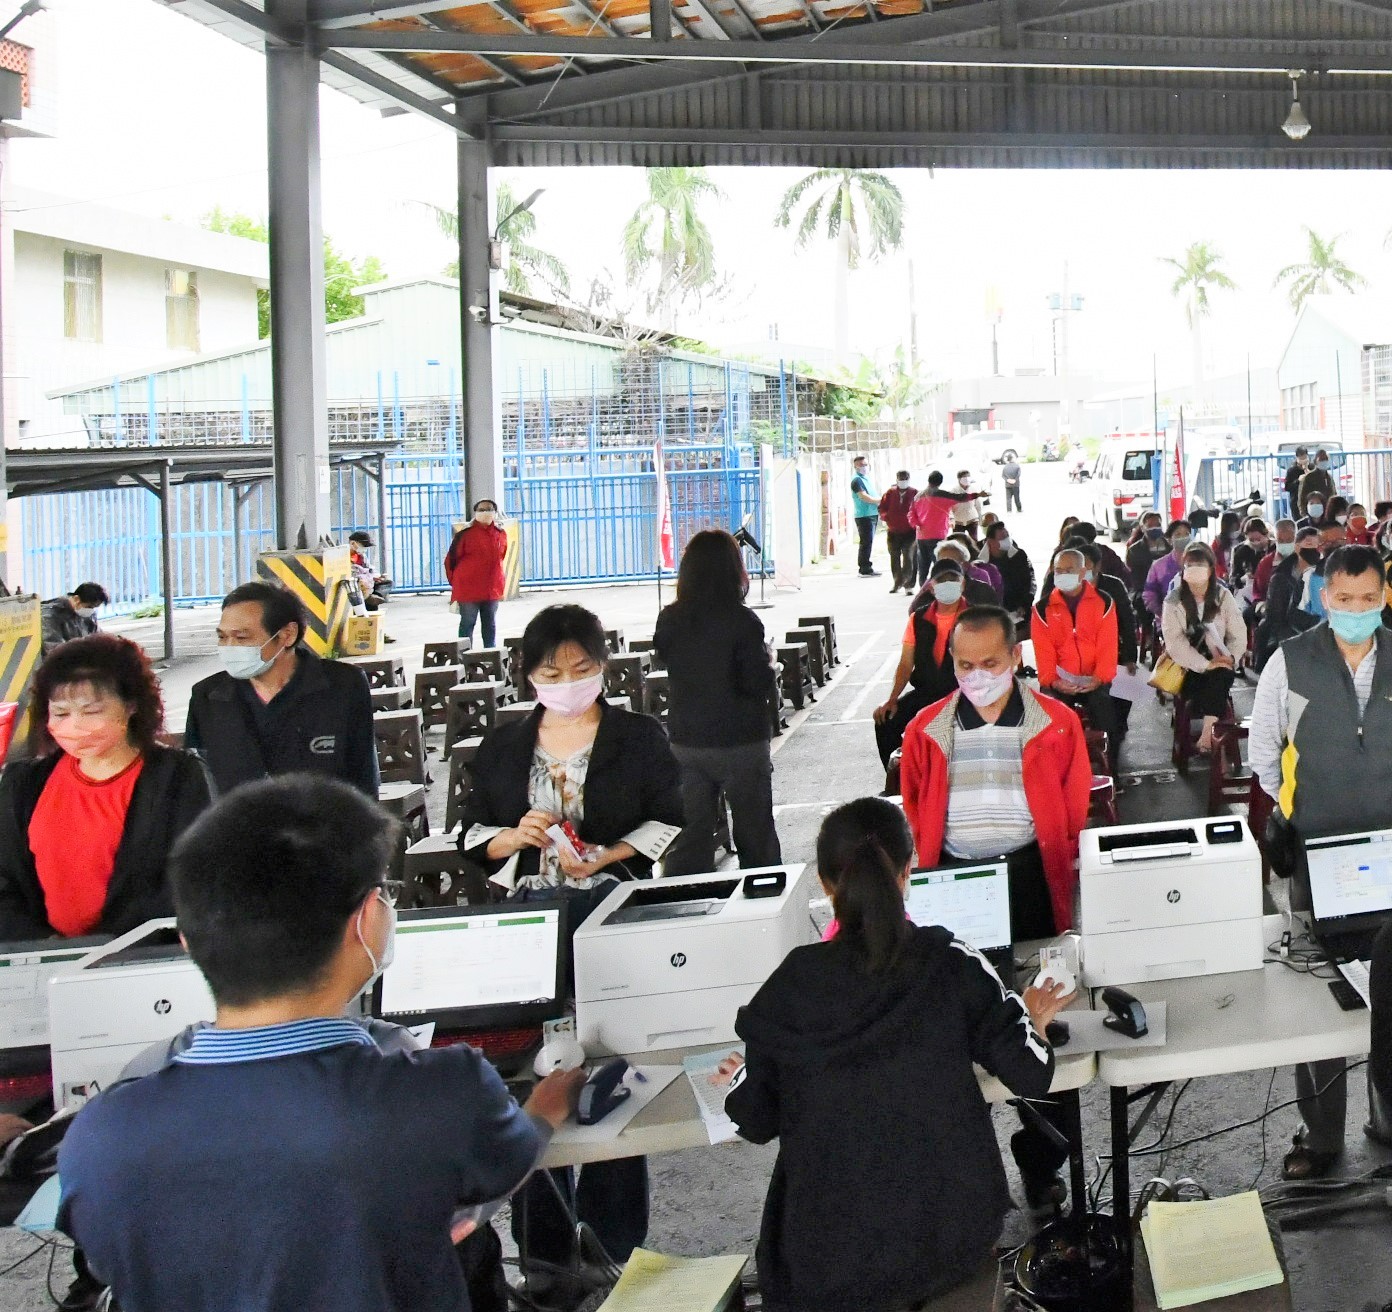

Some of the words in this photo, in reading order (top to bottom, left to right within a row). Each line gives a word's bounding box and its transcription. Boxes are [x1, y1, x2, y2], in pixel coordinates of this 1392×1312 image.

[1166, 889, 1181, 904] hp
[670, 952, 687, 968] hp
[153, 998, 172, 1015] hp
